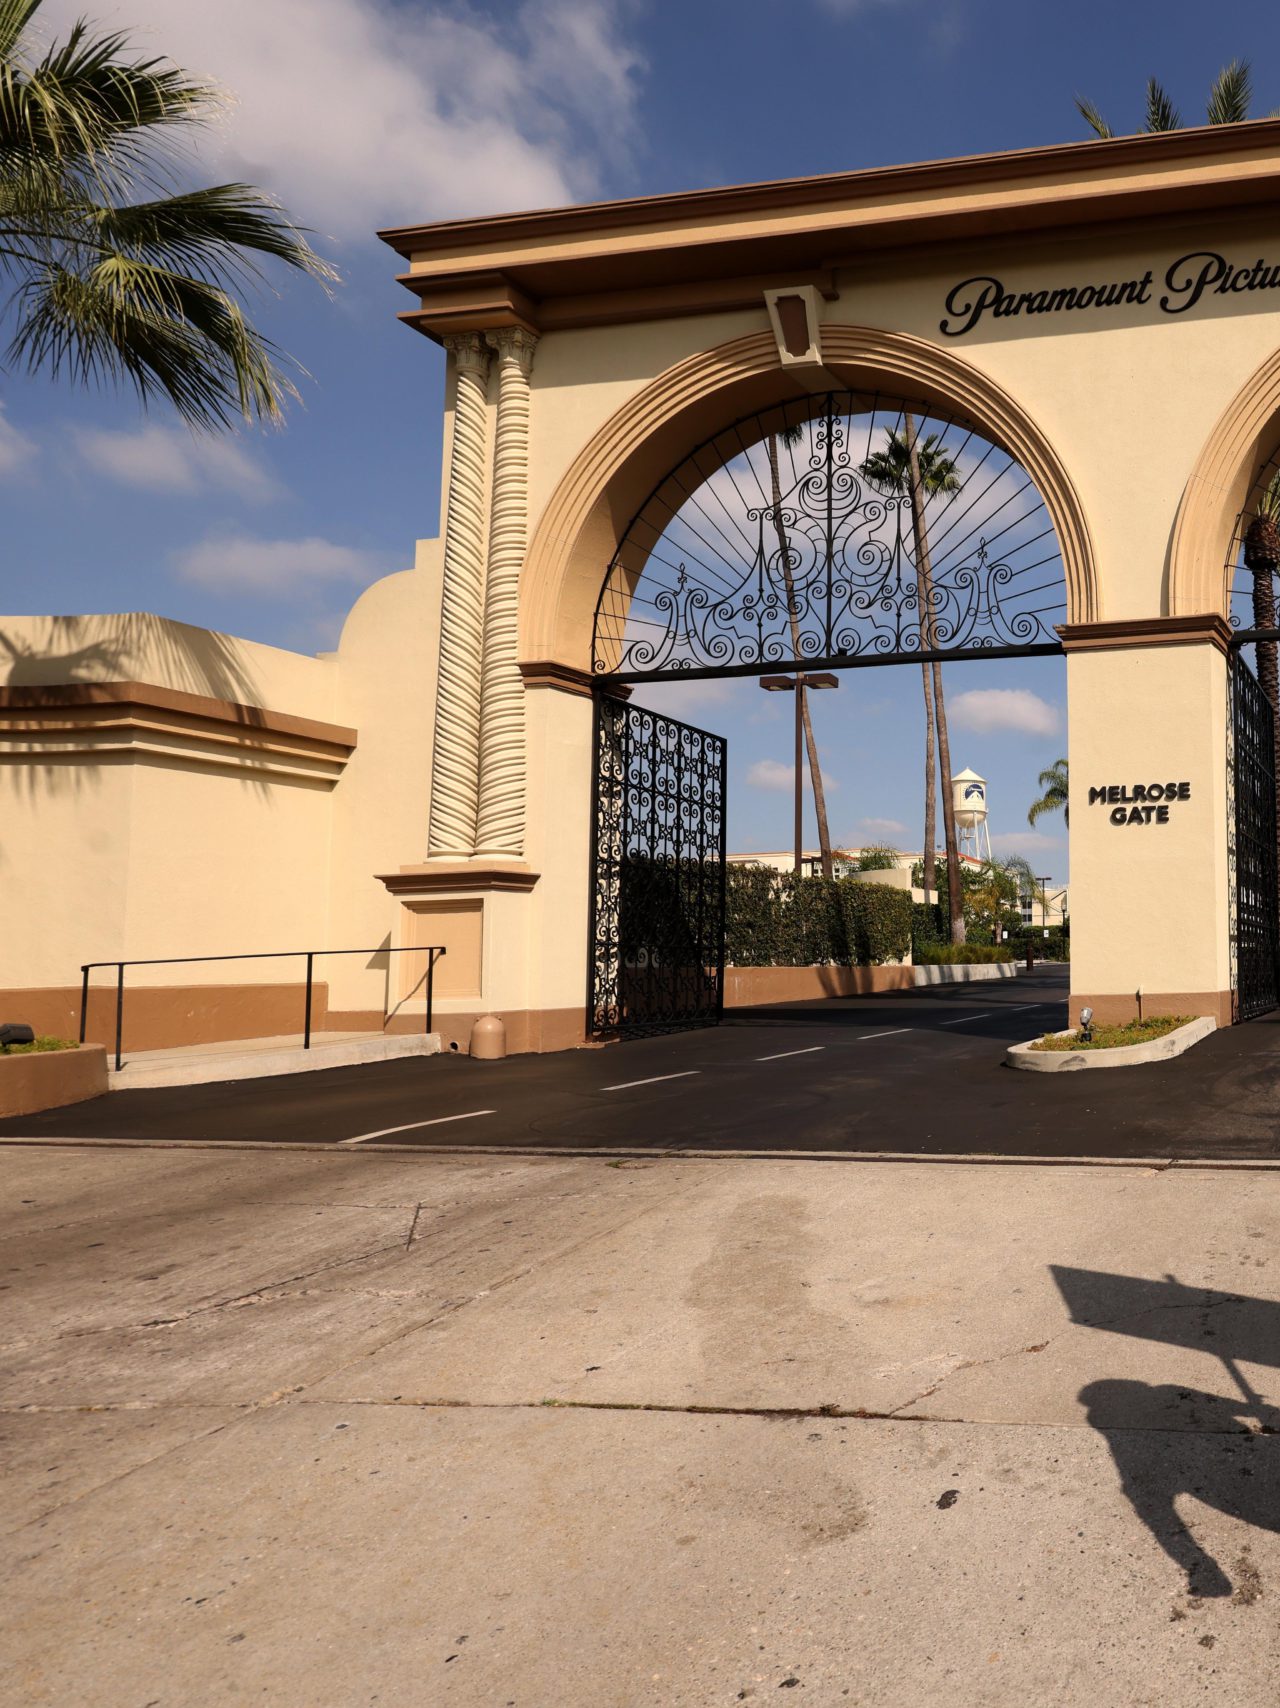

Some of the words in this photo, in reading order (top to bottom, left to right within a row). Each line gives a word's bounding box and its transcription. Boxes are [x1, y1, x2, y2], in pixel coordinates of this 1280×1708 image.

[939, 271, 1153, 337] Paramount
[1088, 782, 1191, 805] MELROSE
[1109, 805, 1169, 826] GATE
